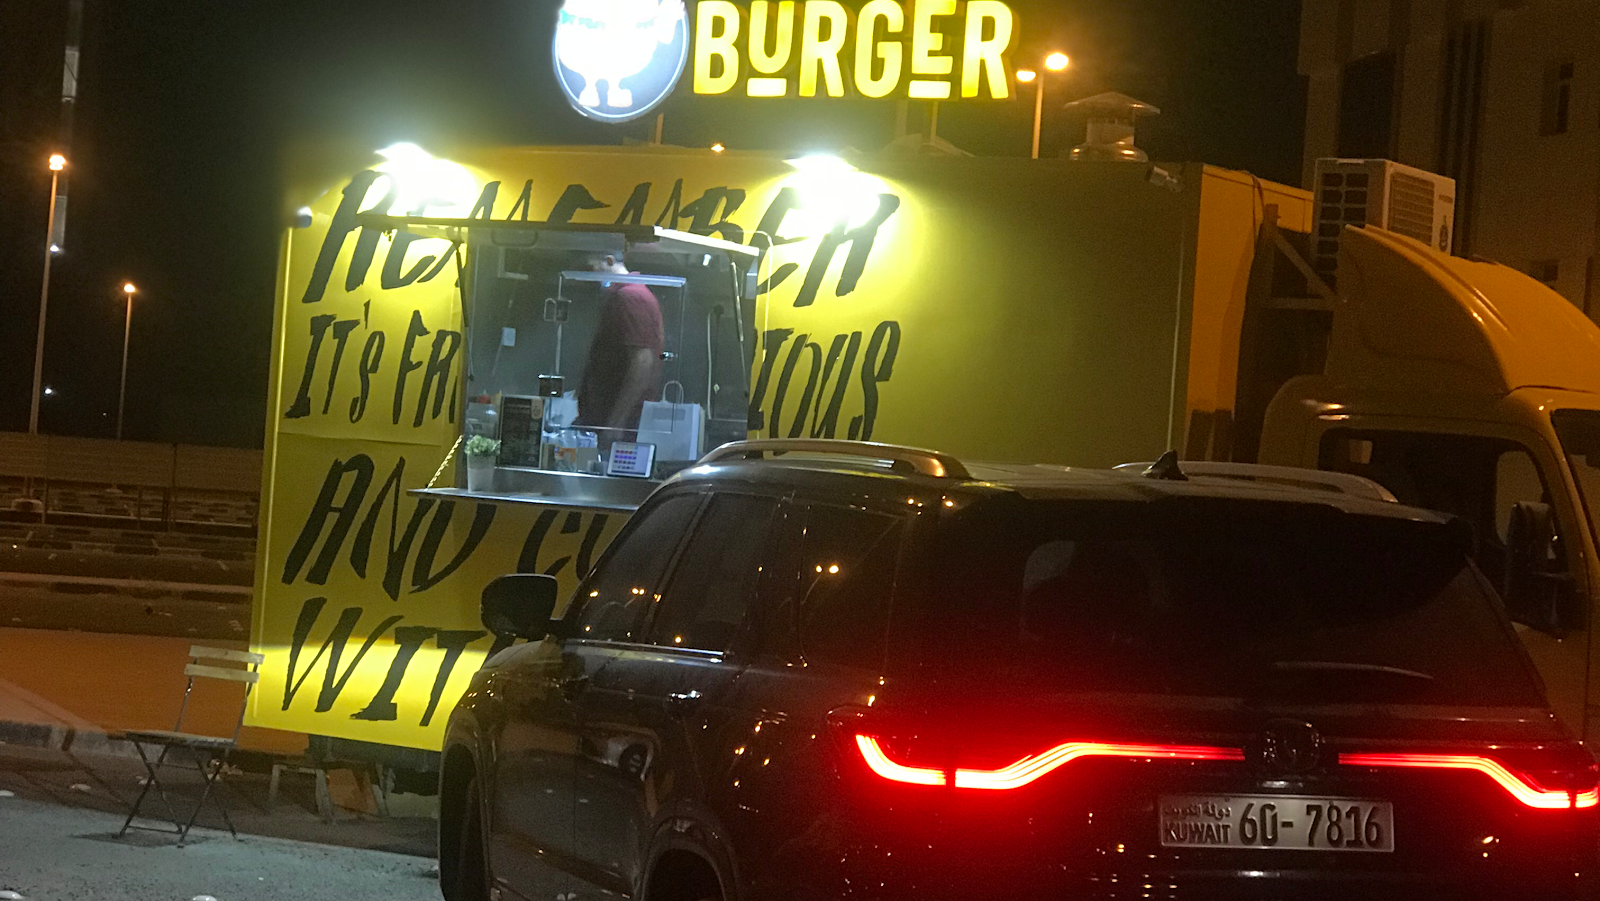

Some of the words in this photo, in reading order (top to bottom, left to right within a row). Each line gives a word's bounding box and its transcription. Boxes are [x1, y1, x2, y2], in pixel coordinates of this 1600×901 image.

[693, 0, 1013, 98] BURGER
[282, 453, 498, 601] AND
[282, 597, 516, 727] WIT
[1165, 821, 1232, 844] KUWAIT
[1305, 803, 1384, 848] 7816
